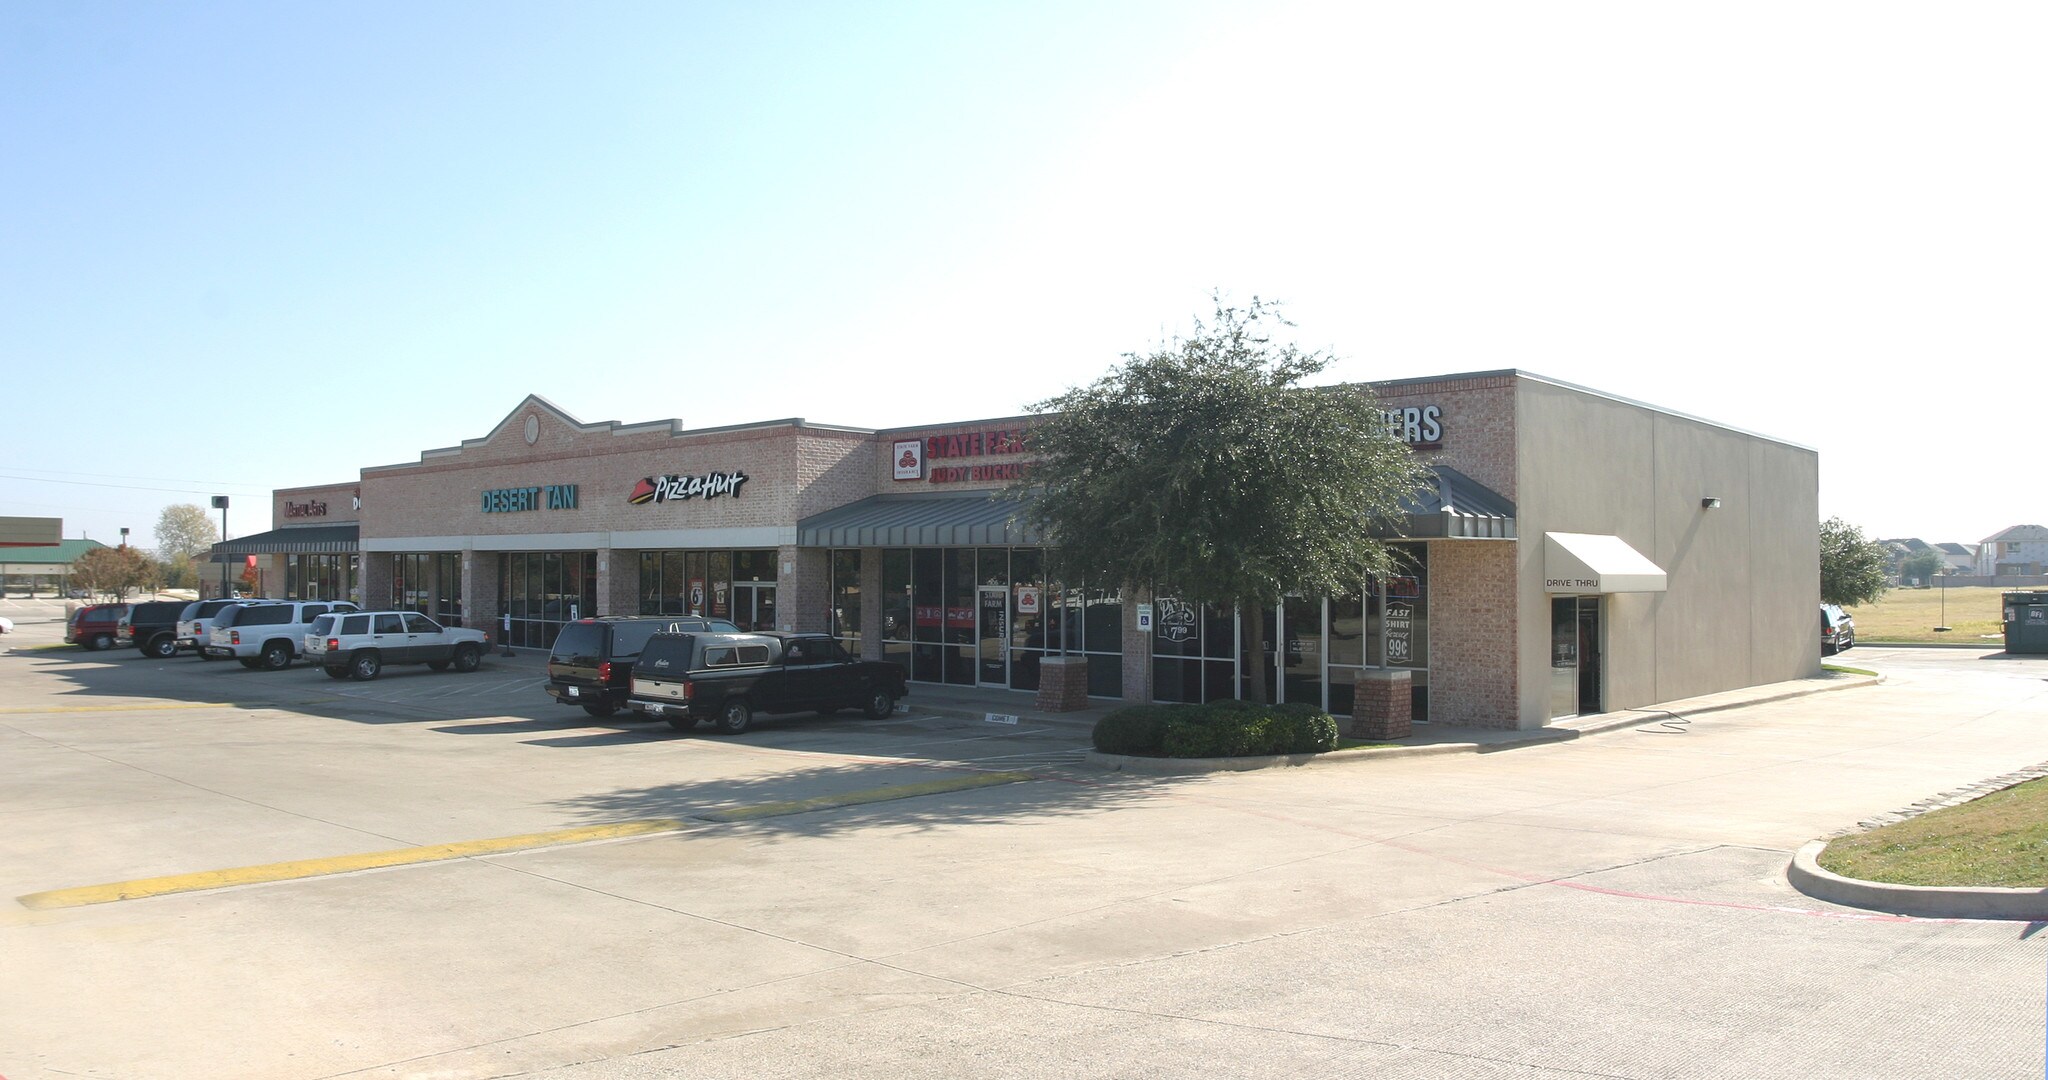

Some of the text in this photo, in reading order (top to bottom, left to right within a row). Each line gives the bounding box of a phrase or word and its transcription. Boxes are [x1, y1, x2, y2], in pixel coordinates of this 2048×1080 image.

[927, 434, 979, 459] STATE
[929, 467, 966, 483] JUDY
[481, 484, 579, 513] DESERT TAN
[1575, 579, 1598, 588] THRU
[984, 600, 1003, 608] FARM
[1385, 608, 1410, 617] FAST
[1385, 620, 1410, 629] SHIRT
